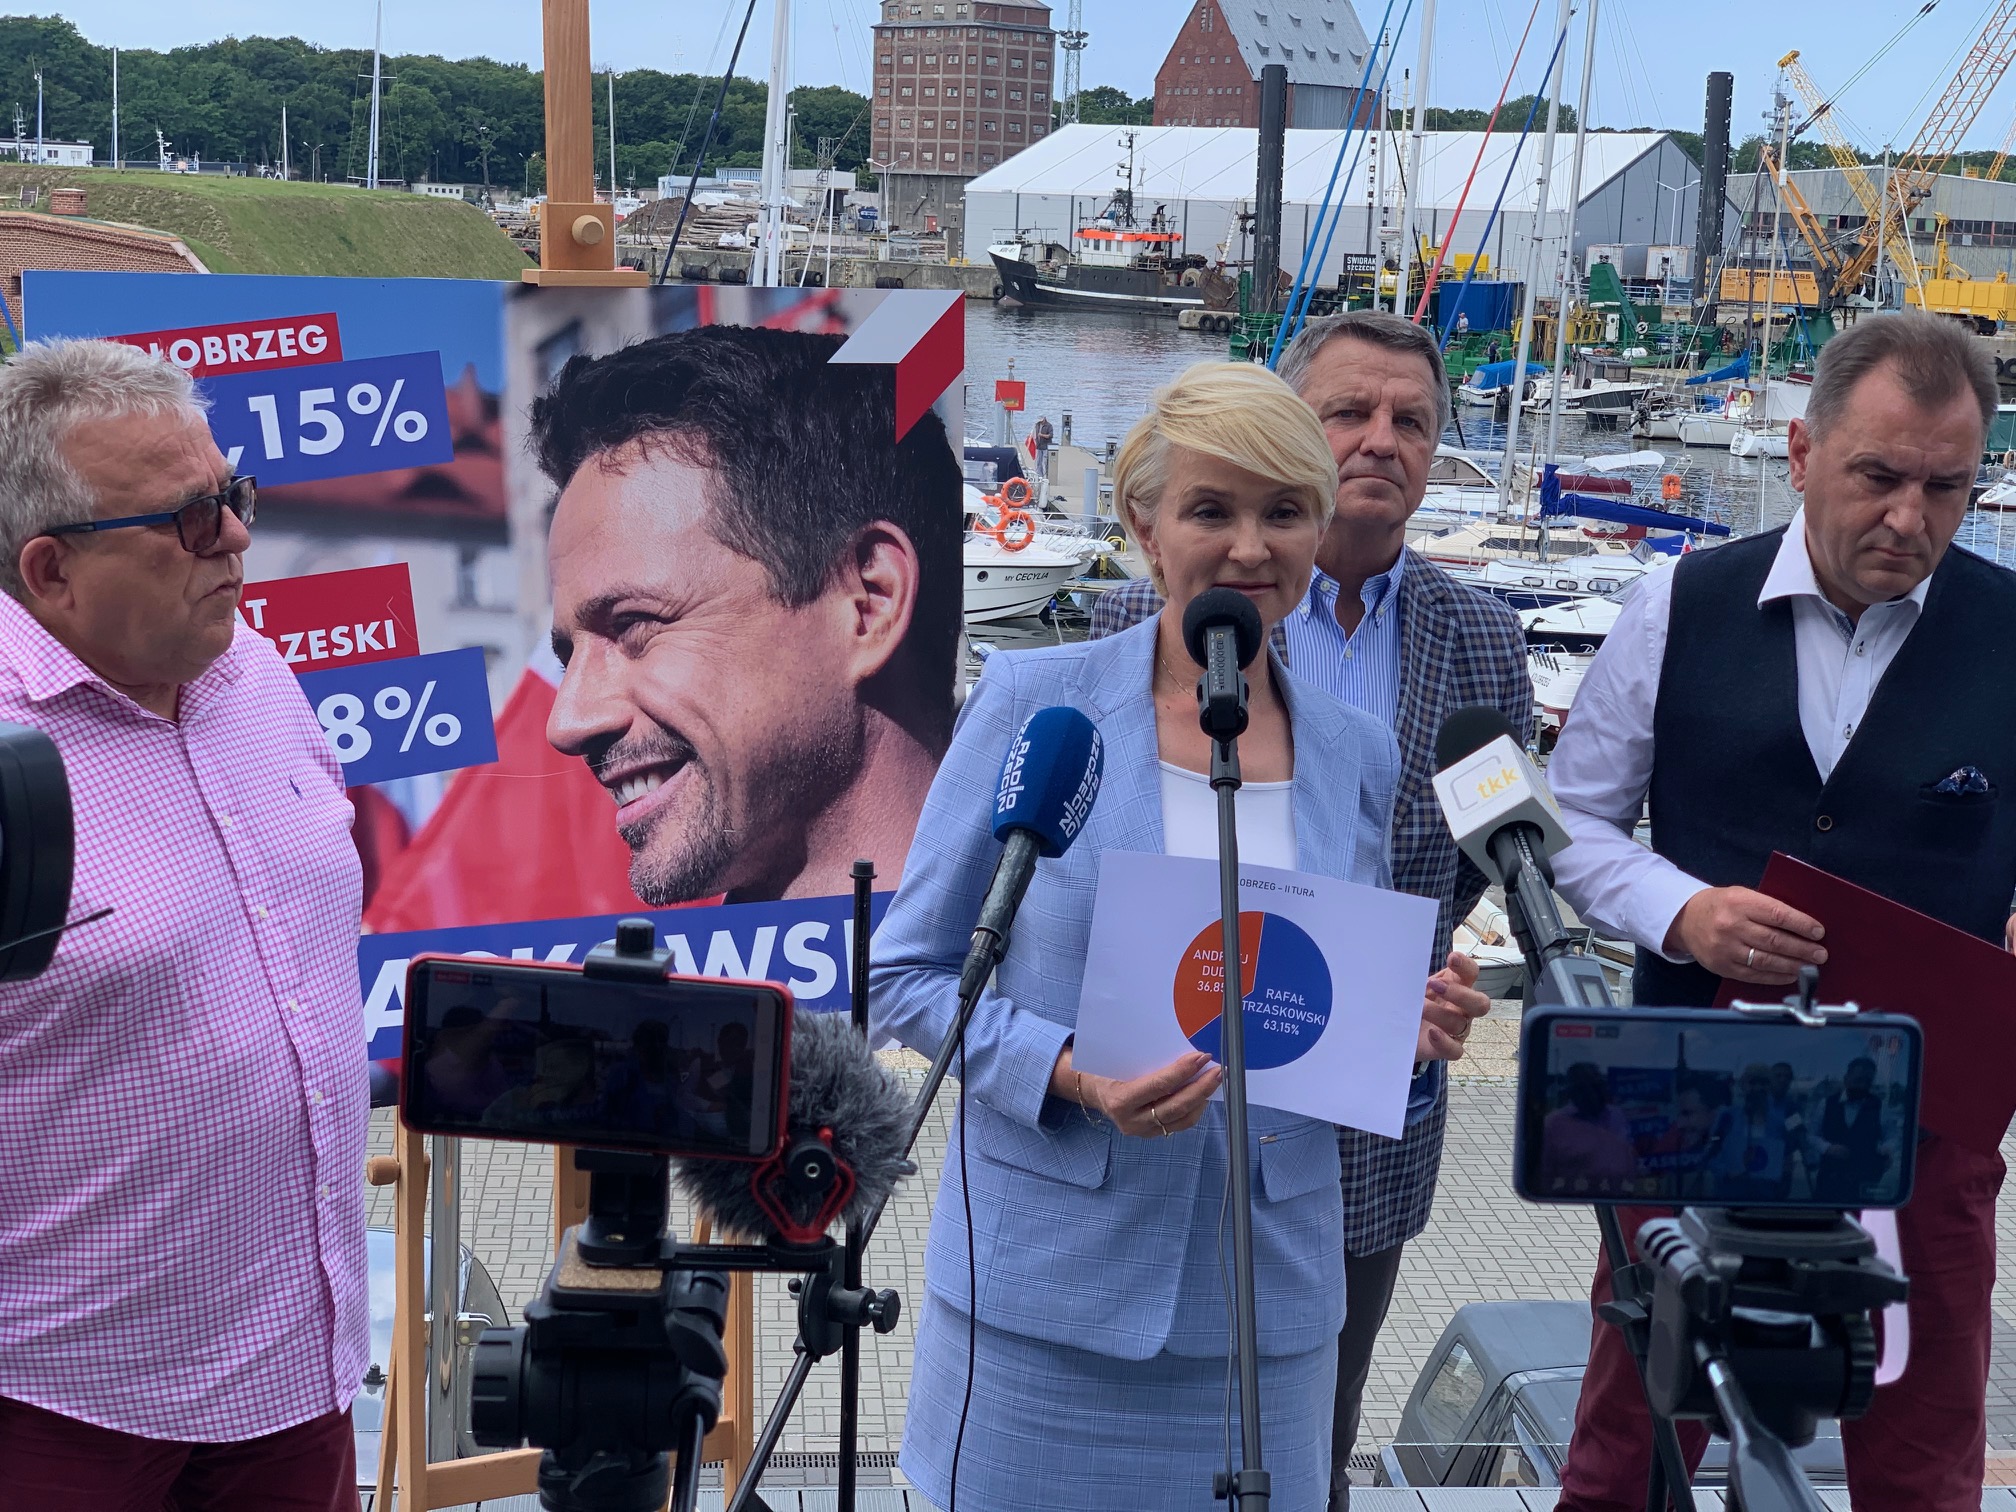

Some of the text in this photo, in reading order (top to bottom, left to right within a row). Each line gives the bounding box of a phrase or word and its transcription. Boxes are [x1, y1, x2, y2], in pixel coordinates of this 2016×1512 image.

[130, 325, 328, 368] ŁOBRZEG
[197, 378, 428, 467] ,15%
[1015, 572, 1049, 581] CECYLIA
[264, 619, 397, 663] ZESKI
[1005, 740, 1031, 810] RADIO
[1058, 729, 1101, 830] SZCZECIN
[1476, 767, 1520, 799] tkk
[1066, 772, 1099, 839] RADIO
[1238, 878, 1276, 891] OBRZEG
[1291, 886, 1315, 898] TURA
[1202, 965, 1225, 978] DUD
[1242, 1000, 1326, 1026] TRZASKOWSKI
[1265, 988, 1306, 1006] RAFAŁ
[1263, 1018, 1300, 1036] 63,15%
